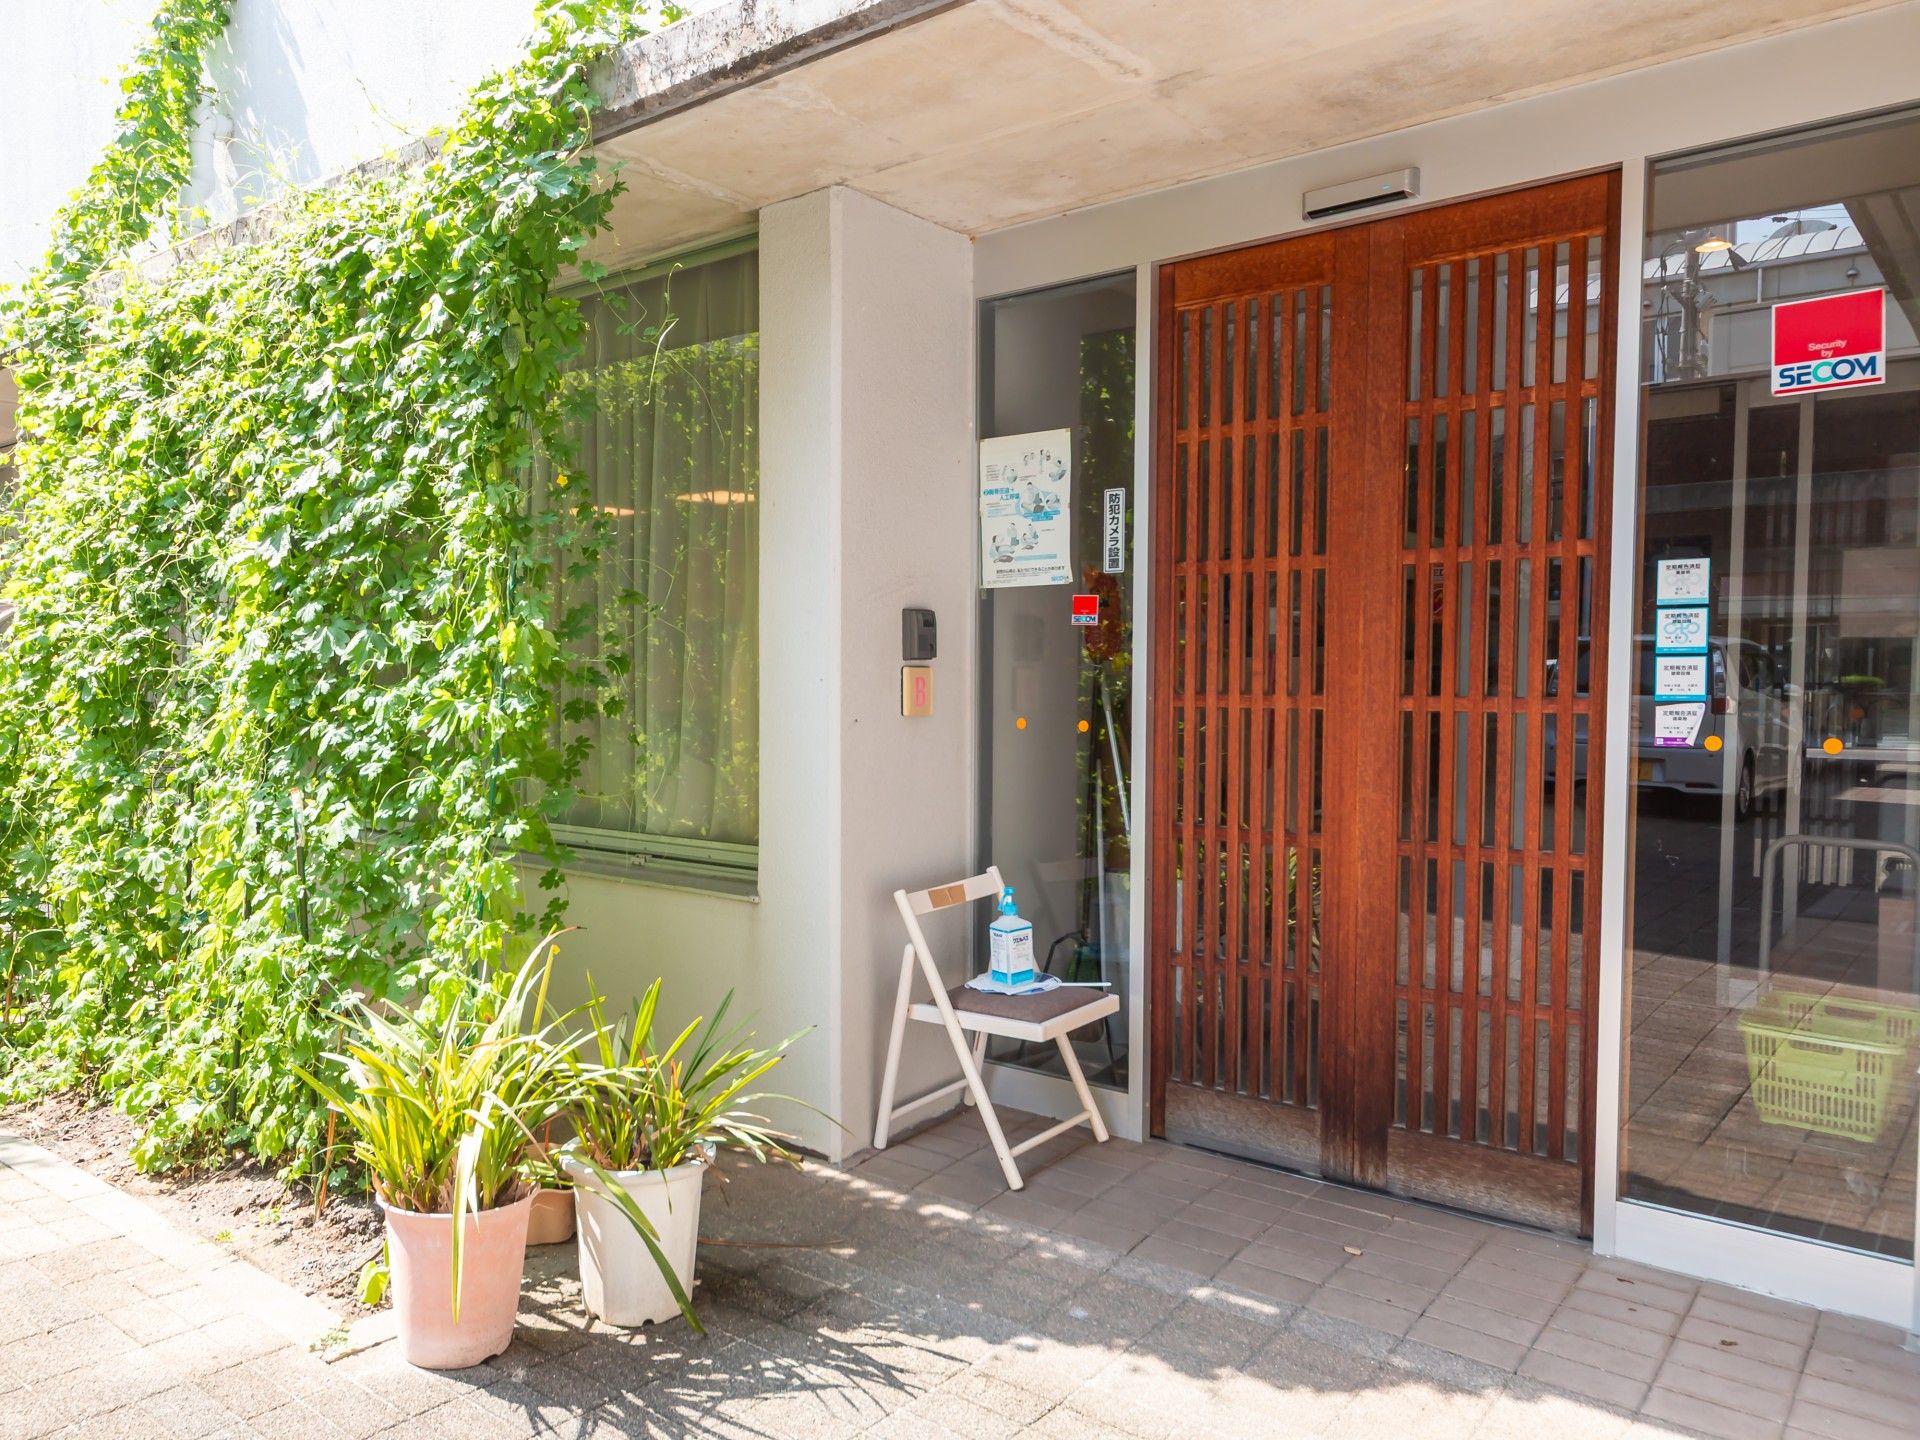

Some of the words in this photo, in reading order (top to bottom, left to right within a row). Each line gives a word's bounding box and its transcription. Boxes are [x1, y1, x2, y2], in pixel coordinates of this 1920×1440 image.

[1807, 339, 1848, 352] Security
[1820, 349, 1834, 358] by
[1779, 355, 1877, 388] SECOM
[1108, 493, 1121, 569] 防犯カメラ設置
[1073, 615, 1096, 623] SECOM
